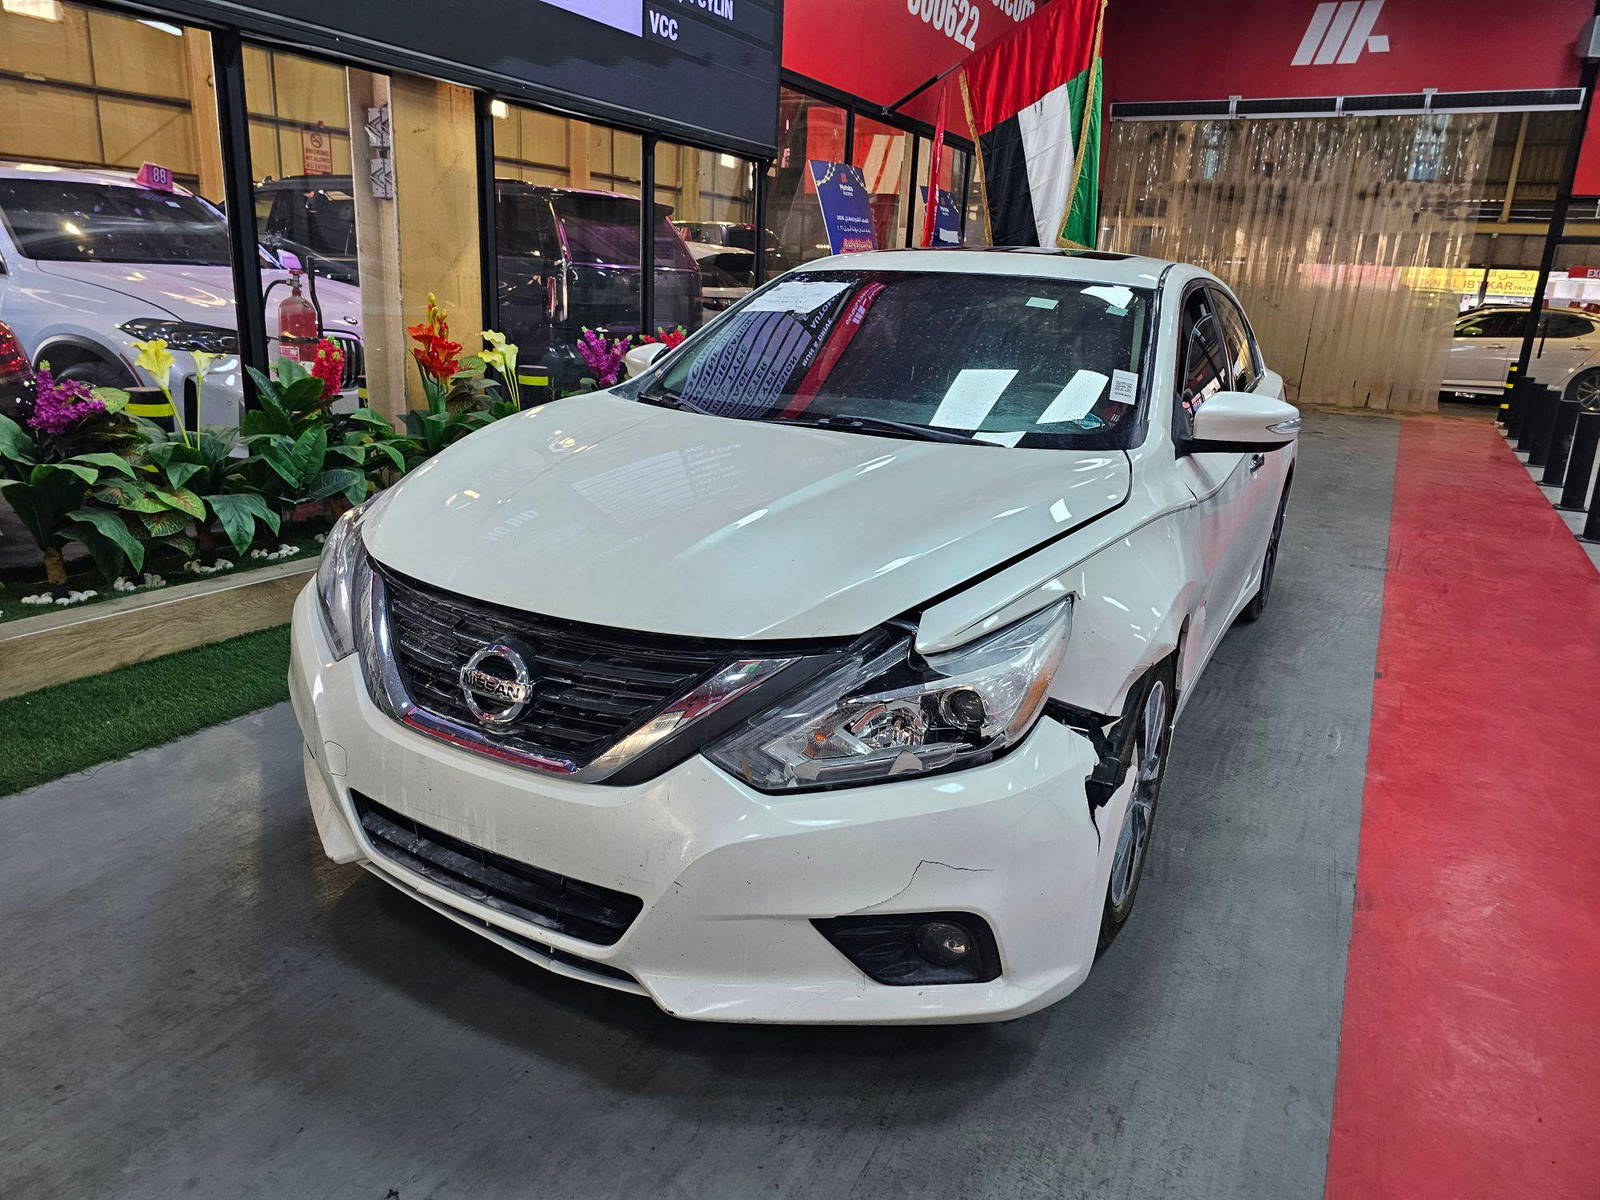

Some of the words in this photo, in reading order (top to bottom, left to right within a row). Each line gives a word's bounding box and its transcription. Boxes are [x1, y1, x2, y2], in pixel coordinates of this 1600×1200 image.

[649, 9, 678, 41] VCC
[153, 168, 167, 183] 88
[1586, 269, 1600, 278] EX
[1463, 280, 1513, 290] IBTKAR
[463, 670, 520, 699] NISSAN
